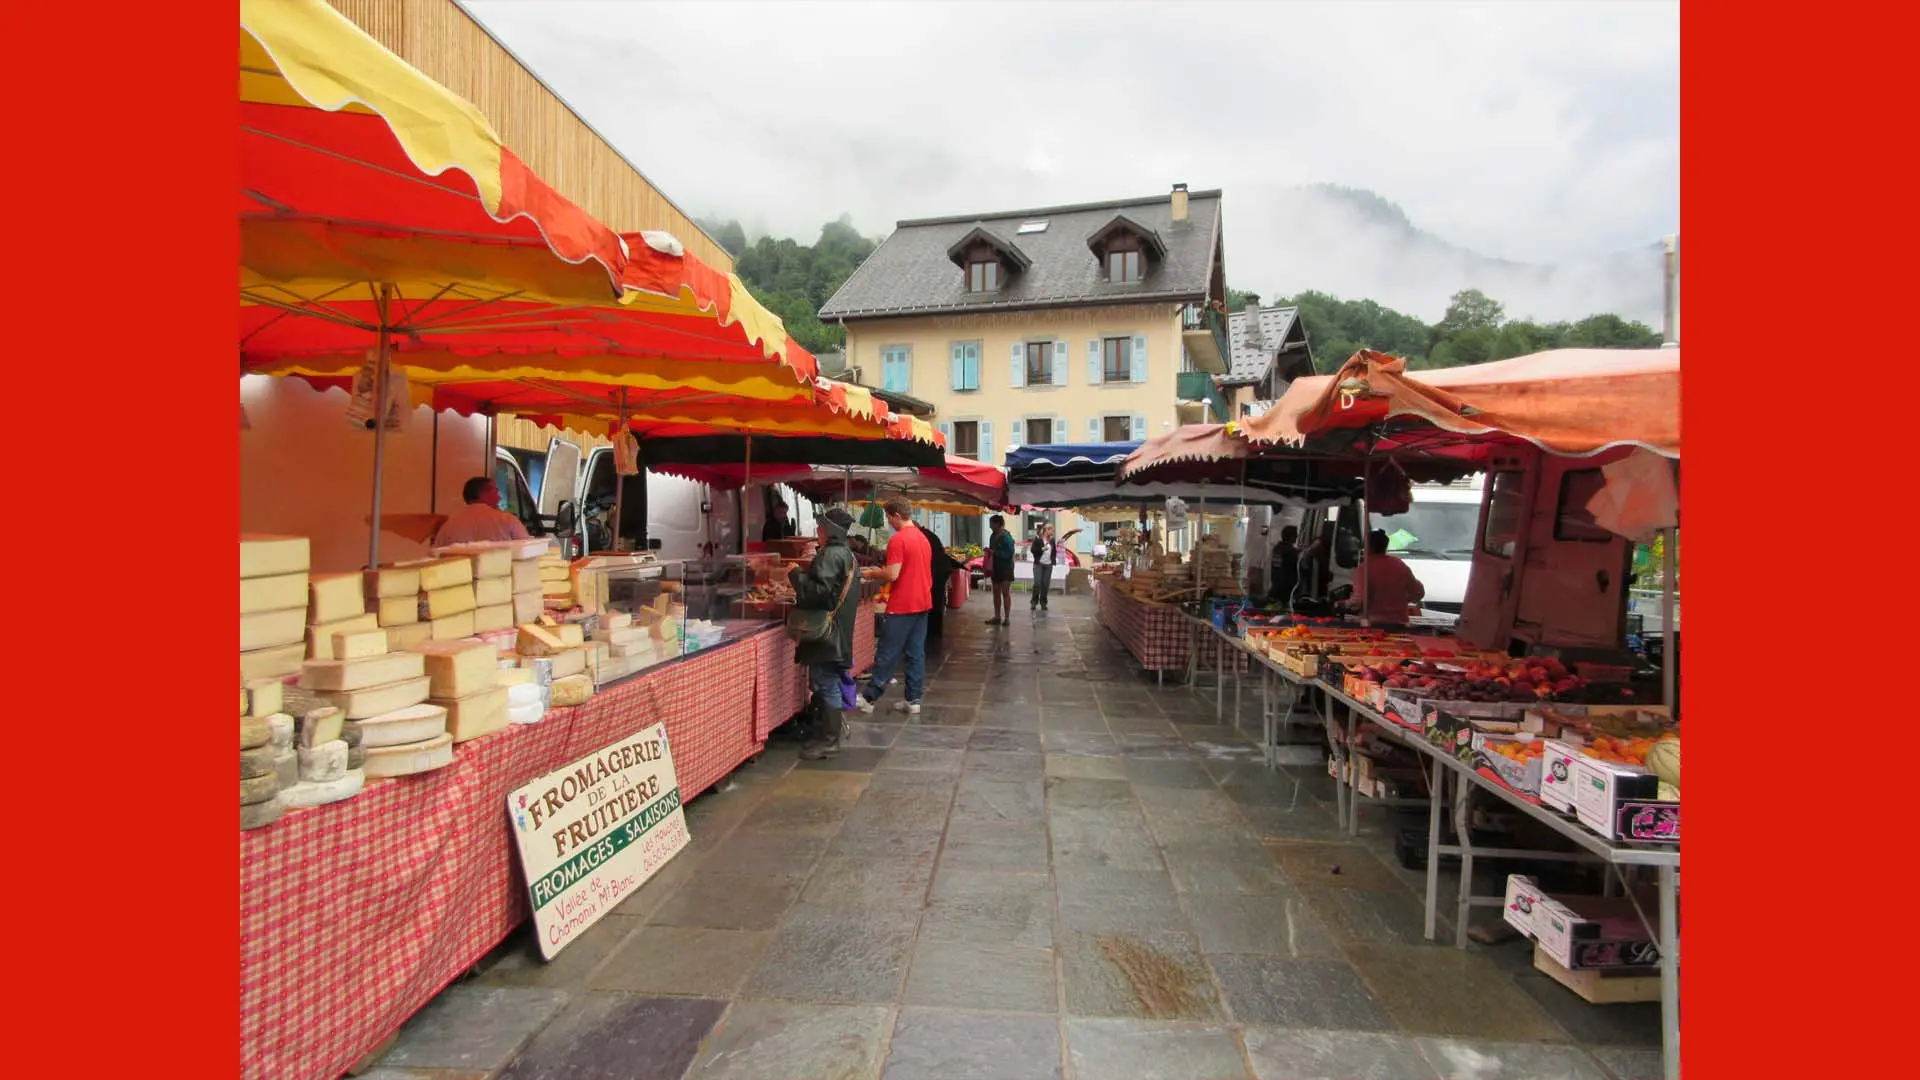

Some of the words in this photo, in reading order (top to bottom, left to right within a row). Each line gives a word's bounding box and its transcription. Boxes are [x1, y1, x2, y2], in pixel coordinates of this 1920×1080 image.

[529, 740, 661, 831] FROMAGERIE
[553, 774, 660, 857] FRUITIERE
[588, 786, 607, 806] DE
[612, 774, 631, 793] LA
[535, 837, 614, 906] FROMAGES
[626, 790, 679, 841] SALAISONS
[549, 903, 597, 945] Chamonix
[613, 874, 635, 898] Blanc
[555, 889, 587, 921] Vallée
[590, 876, 601, 892] de
